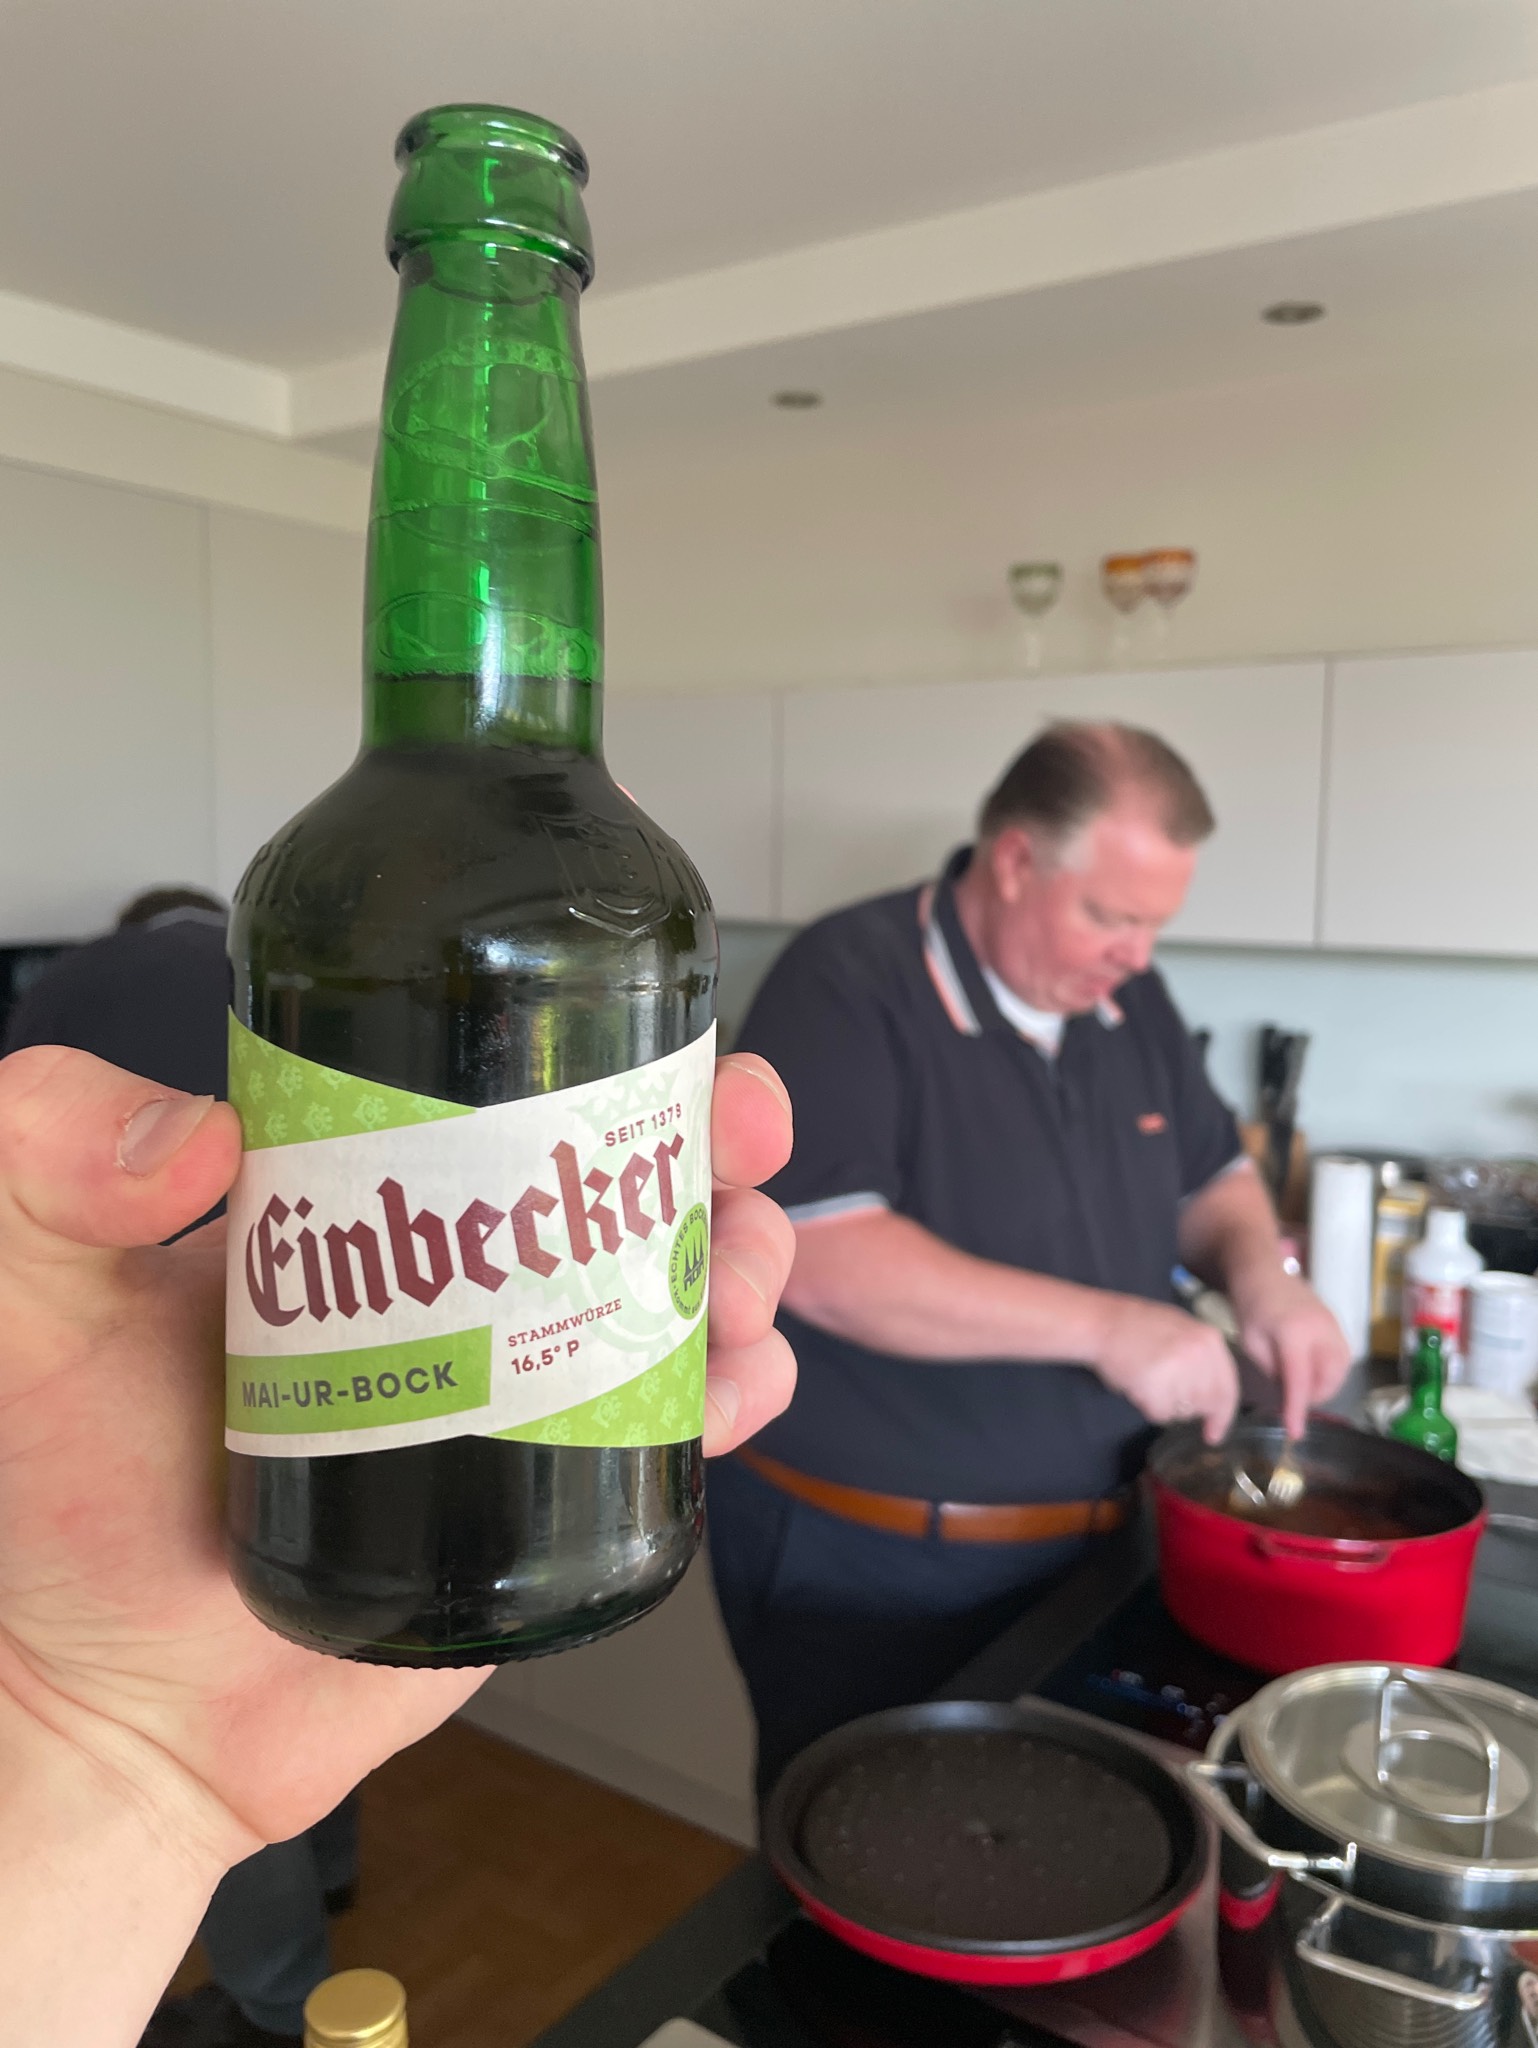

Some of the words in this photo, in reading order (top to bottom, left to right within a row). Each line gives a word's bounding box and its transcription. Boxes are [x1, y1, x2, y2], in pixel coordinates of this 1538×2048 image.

[604, 1119, 645, 1147] SEIT
[651, 1102, 682, 1130] 1378
[245, 1133, 685, 1328] Einbecker
[507, 1298, 622, 1347] STAMMWÜRZE
[511, 1345, 561, 1375] 16,5°
[566, 1339, 580, 1358] P
[241, 1360, 459, 1409] MAI-UR-BOCK
